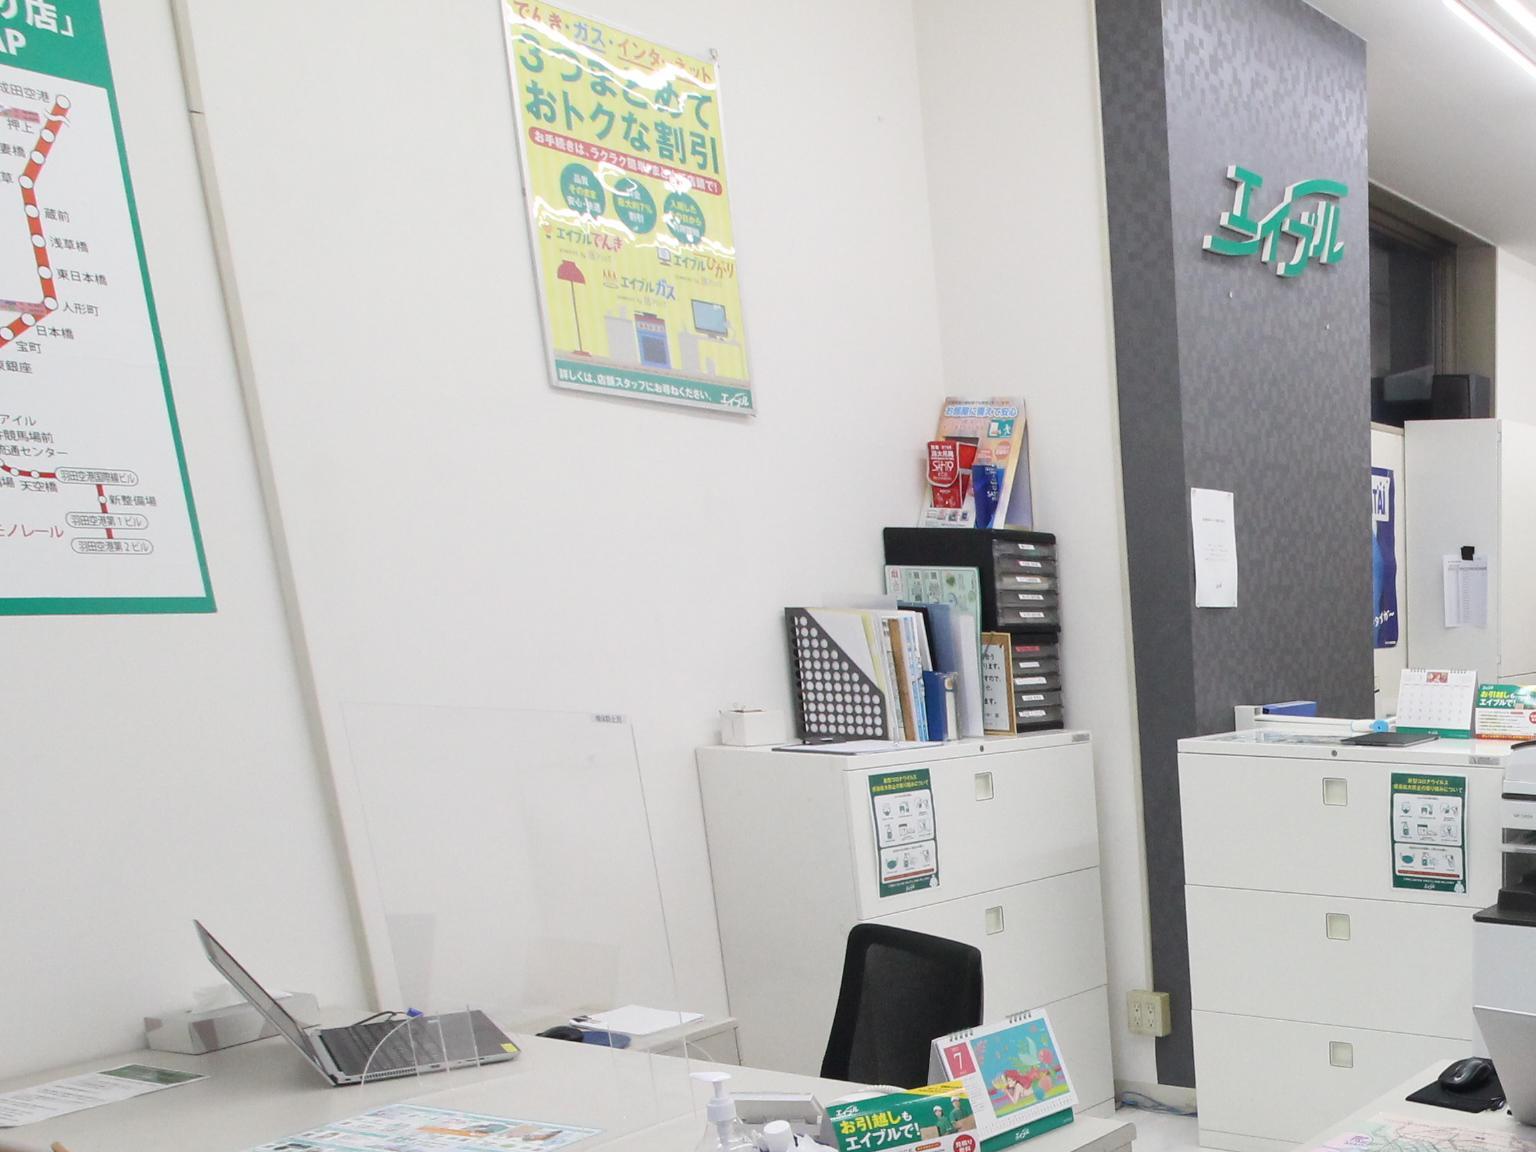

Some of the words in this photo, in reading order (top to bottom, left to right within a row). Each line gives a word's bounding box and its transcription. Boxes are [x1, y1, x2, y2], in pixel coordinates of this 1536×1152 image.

[0, 82, 50, 103] 成田空港
[7, 119, 34, 134] 押上
[526, 79, 720, 174] おトクな割引
[44, 208, 70, 222] 蔵前
[1202, 164, 1349, 278] エイブル
[50, 237, 89, 252] 浅草橋
[557, 227, 624, 252] エイブルでんき
[57, 268, 107, 286] 東日本橋
[621, 275, 676, 300] エイブルガス
[62, 302, 99, 316] 人形町
[36, 325, 75, 340] 日本橋
[16, 341, 42, 354] 宝町
[0, 429, 55, 444] 競馬場前
[21, 480, 58, 493] 天空橋
[109, 495, 157, 507] 新整備場
[953, 1052, 963, 1071] 7
[840, 1110, 913, 1135] お引越しも
[846, 1122, 921, 1152] エイブルで!
